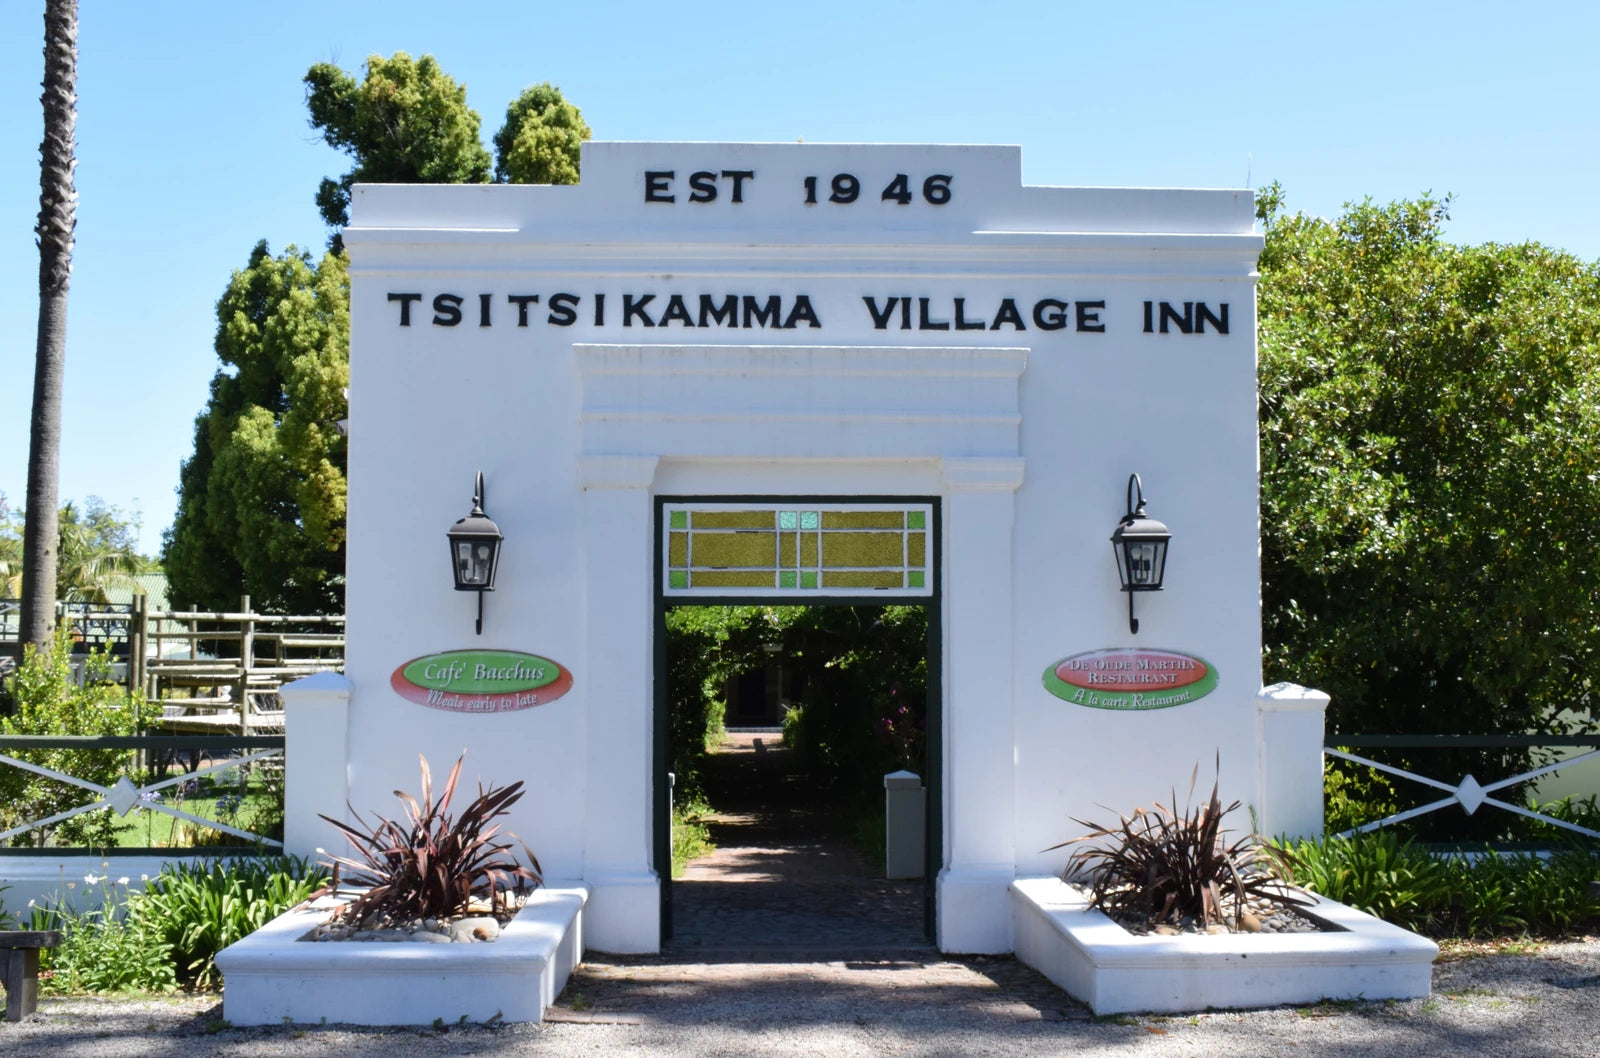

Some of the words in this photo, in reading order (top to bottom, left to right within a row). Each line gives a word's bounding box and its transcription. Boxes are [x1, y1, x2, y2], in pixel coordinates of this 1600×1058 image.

[645, 170, 754, 204] EST
[804, 173, 953, 205] 1946
[387, 293, 822, 329] TSITSIKAMMA
[862, 296, 1105, 333] VILLAGE
[1143, 300, 1230, 335] INN
[474, 660, 545, 680] Bacchus
[1070, 659, 1089, 671] DE
[1094, 659, 1132, 671] OUDE
[1136, 659, 1195, 671] MARTHA
[1088, 672, 1177, 684] RESTAURANT
[426, 689, 463, 709] Meals
[467, 696, 496, 712] early
[501, 698, 512, 709] to
[516, 692, 538, 707] late
[1072, 688, 1085, 701] A
[1088, 692, 1098, 705] la
[1102, 696, 1128, 708] carte
[1131, 690, 1190, 708] Restaurant
